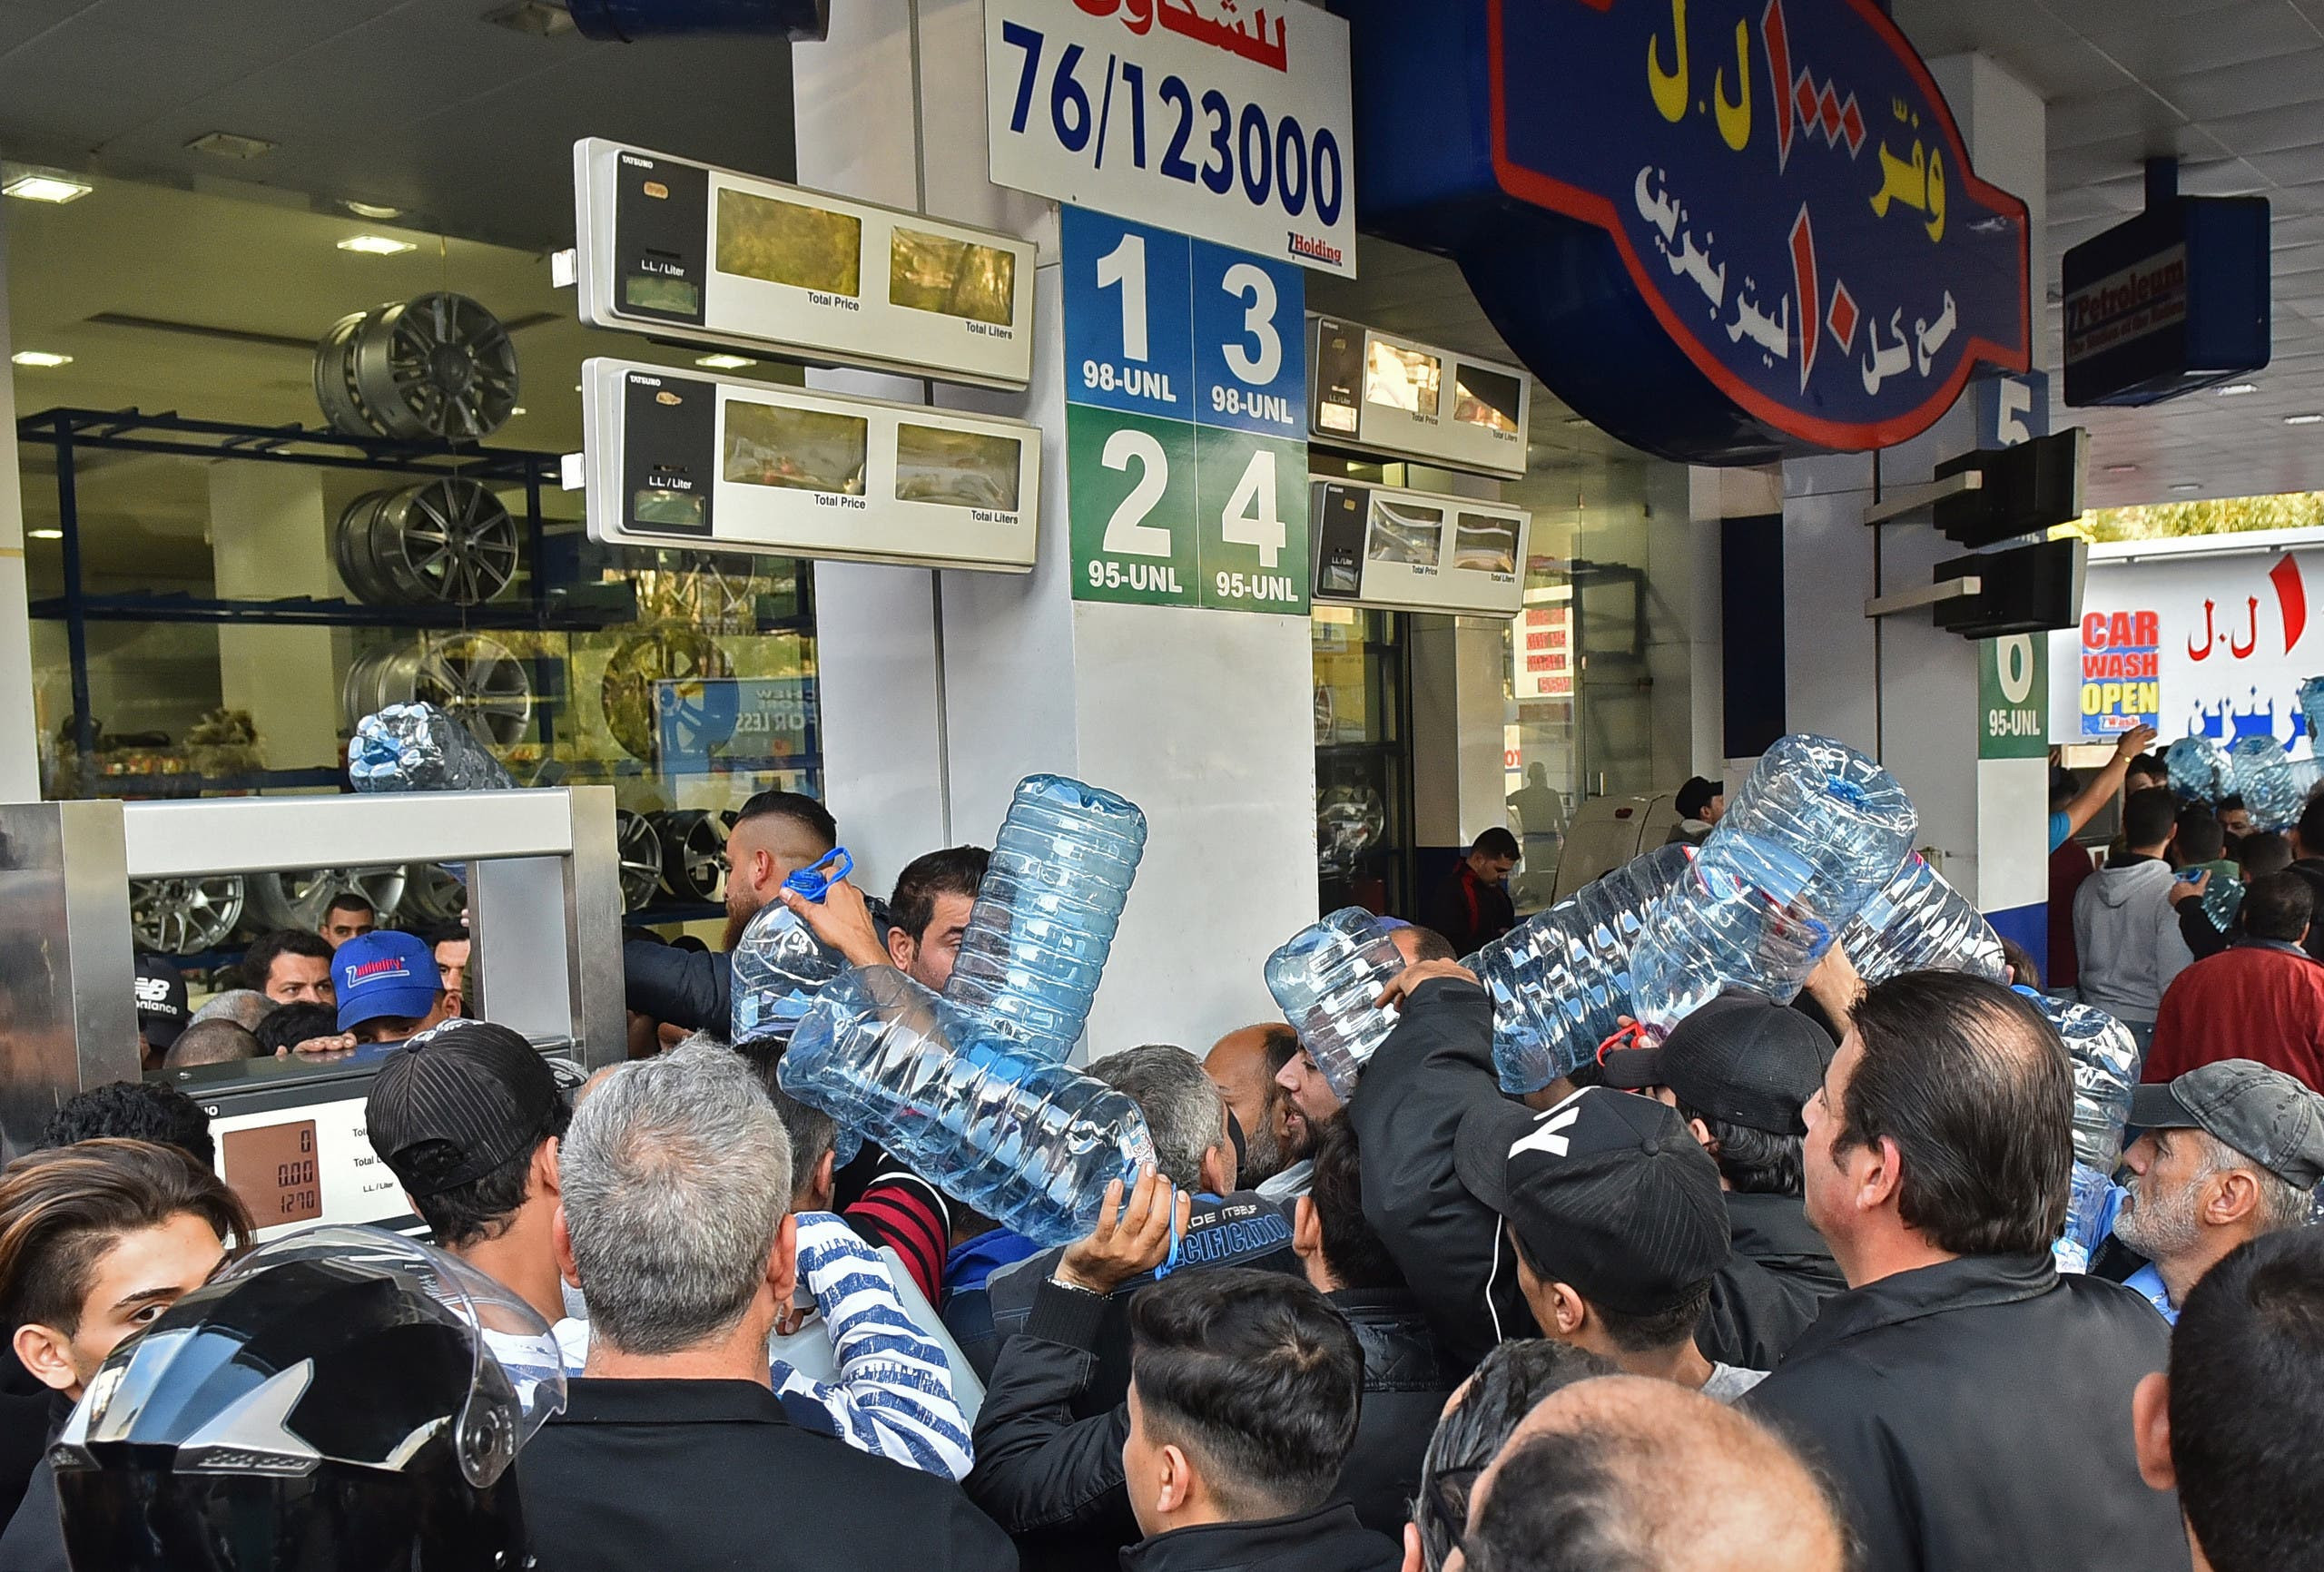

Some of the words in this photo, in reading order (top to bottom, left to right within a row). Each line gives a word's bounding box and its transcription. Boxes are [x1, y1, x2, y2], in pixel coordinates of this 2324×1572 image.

[1002, 19, 1343, 227] 76/123000
[807, 291, 835, 308] Total
[836, 295, 860, 311] Price
[1097, 232, 1147, 362] 1
[965, 321, 986, 336] Total
[988, 325, 1013, 339] Liters
[1221, 262, 1282, 385] 3
[1915, 290, 1957, 378] مع
[1861, 306, 1912, 397] كل
[1083, 360, 1177, 403] 98-UNL
[1212, 386, 1294, 424] 98-UNL
[1412, 412, 1424, 423] Total
[1426, 415, 1439, 426] Price
[1998, 378, 2032, 449] 5
[813, 494, 841, 508] Total
[842, 496, 866, 510] Price
[1101, 428, 1171, 558] 2
[1221, 449, 1285, 568] 4
[971, 510, 991, 523] Total
[993, 512, 1019, 525] Liters
[1088, 560, 1183, 594] 95-UNL
[1412, 565, 1424, 574] Total
[1425, 566, 1438, 575] Price
[1216, 572, 1299, 603] 95-UNL
[2082, 610, 2159, 649] CAR
[2082, 653, 2159, 679] WASH
[2081, 682, 2159, 716] OPEN
[1989, 709, 2041, 737] 95-UNL
[300, 1130, 311, 1153] 0
[278, 1160, 313, 1187] 0.00
[354, 1157, 374, 1167] Total
